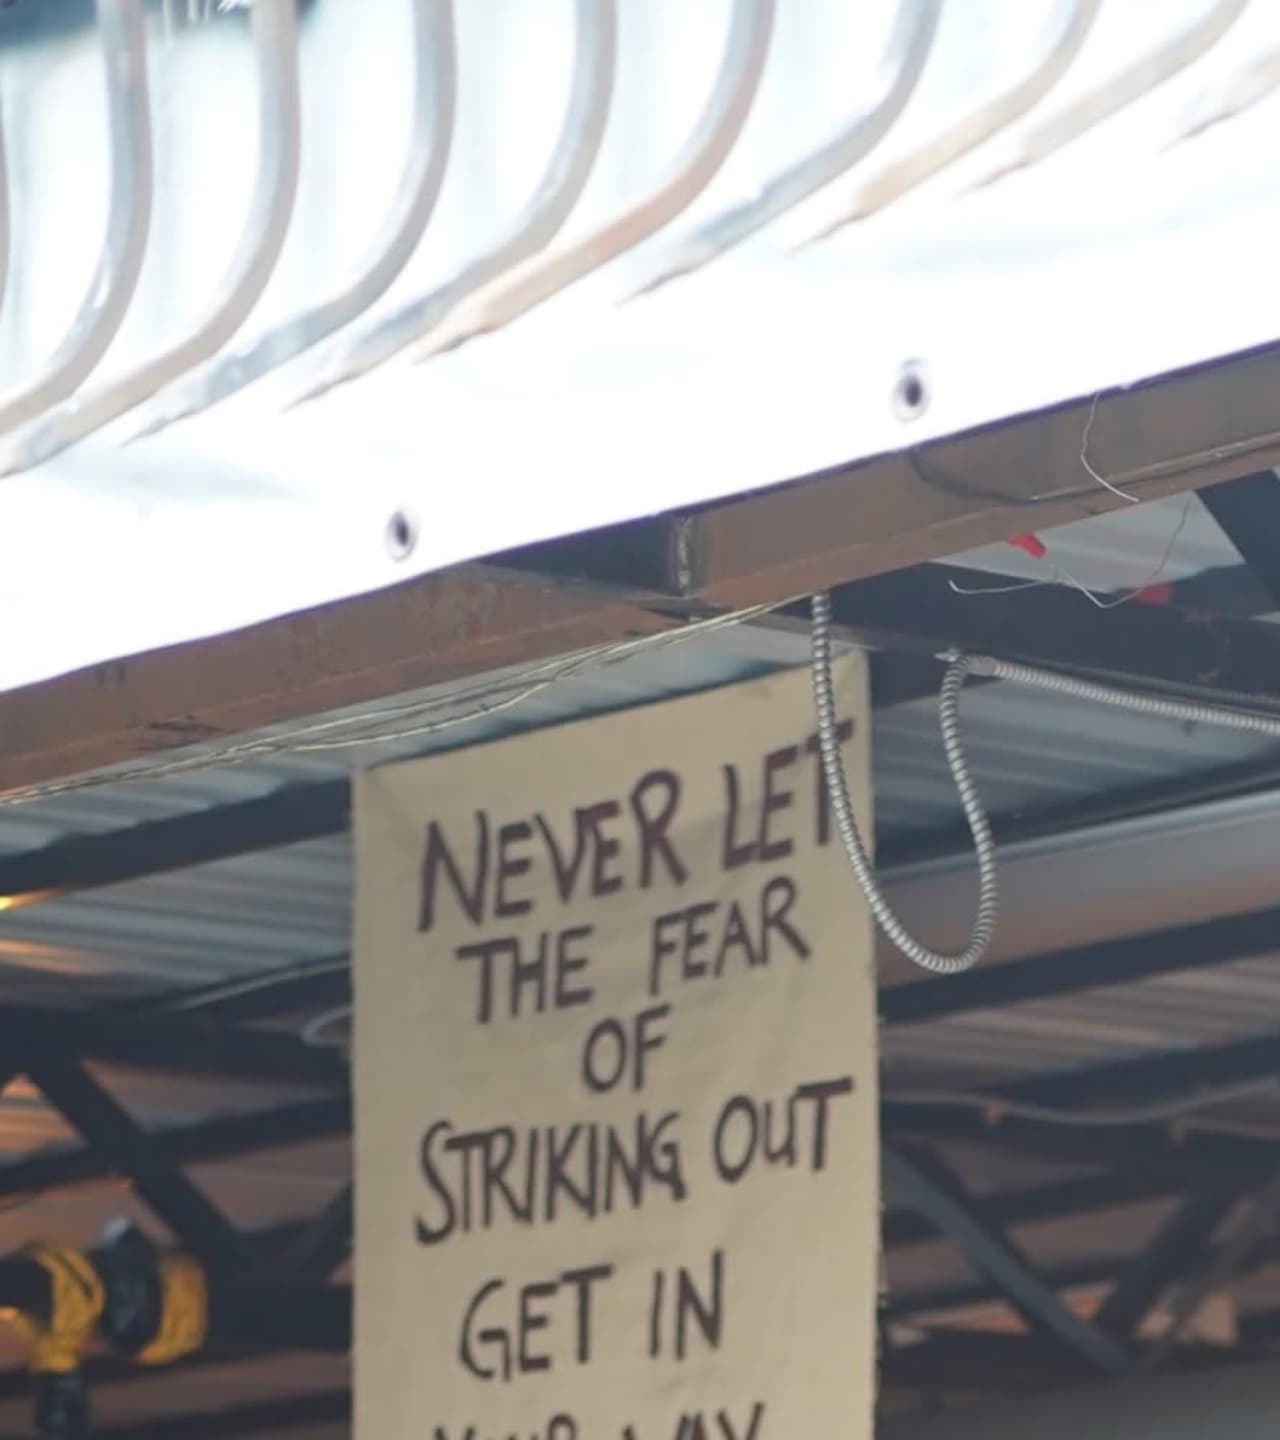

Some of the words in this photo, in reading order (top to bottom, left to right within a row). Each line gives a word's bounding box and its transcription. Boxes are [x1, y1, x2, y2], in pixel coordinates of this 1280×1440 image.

[416, 769, 688, 933] NEVER
[455, 923, 595, 1025] THE
[648, 875, 811, 996] FEAR
[581, 1003, 672, 1093] OF
[414, 1109, 689, 1245] STRIKING
[713, 1075, 855, 1185] OUT
[458, 1263, 613, 1381] GET
[648, 1248, 724, 1362] IN
